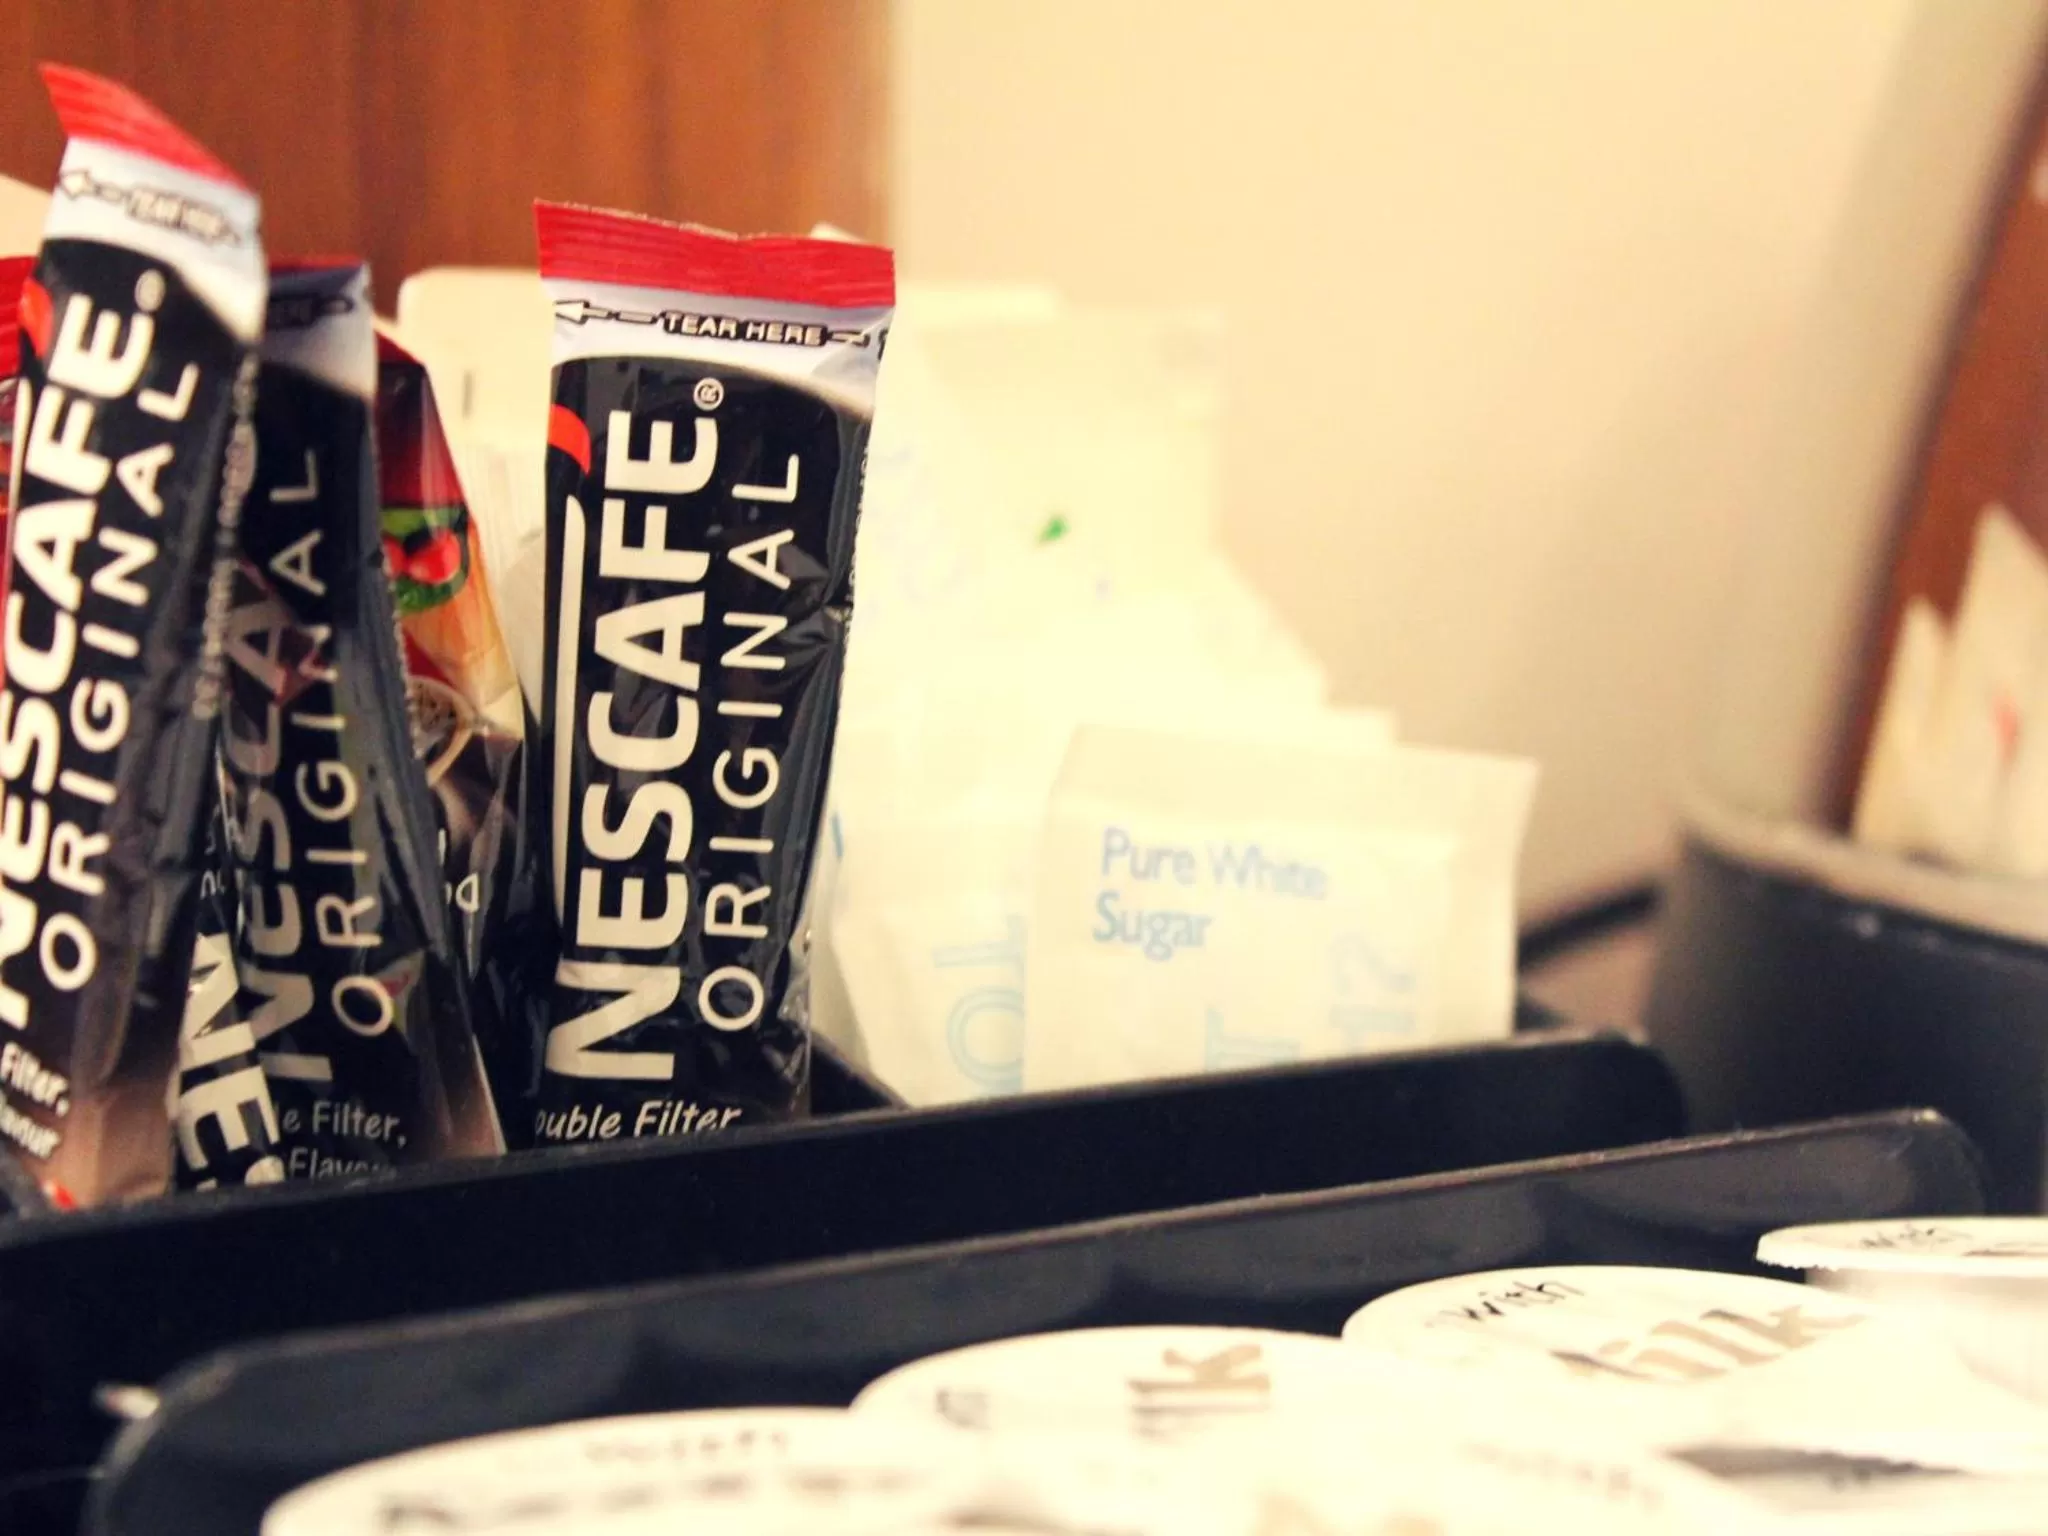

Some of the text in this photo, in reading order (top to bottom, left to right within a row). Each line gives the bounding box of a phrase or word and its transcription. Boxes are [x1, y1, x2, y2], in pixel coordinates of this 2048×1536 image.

[663, 312, 824, 346] TEAR HERE
[39, 361, 200, 992] ORIGINAL
[698, 453, 800, 1031] ORIGINAL
[1102, 826, 1197, 886] Pure
[1092, 889, 1214, 963] Sugar
[534, 1103, 623, 1140] ouble
